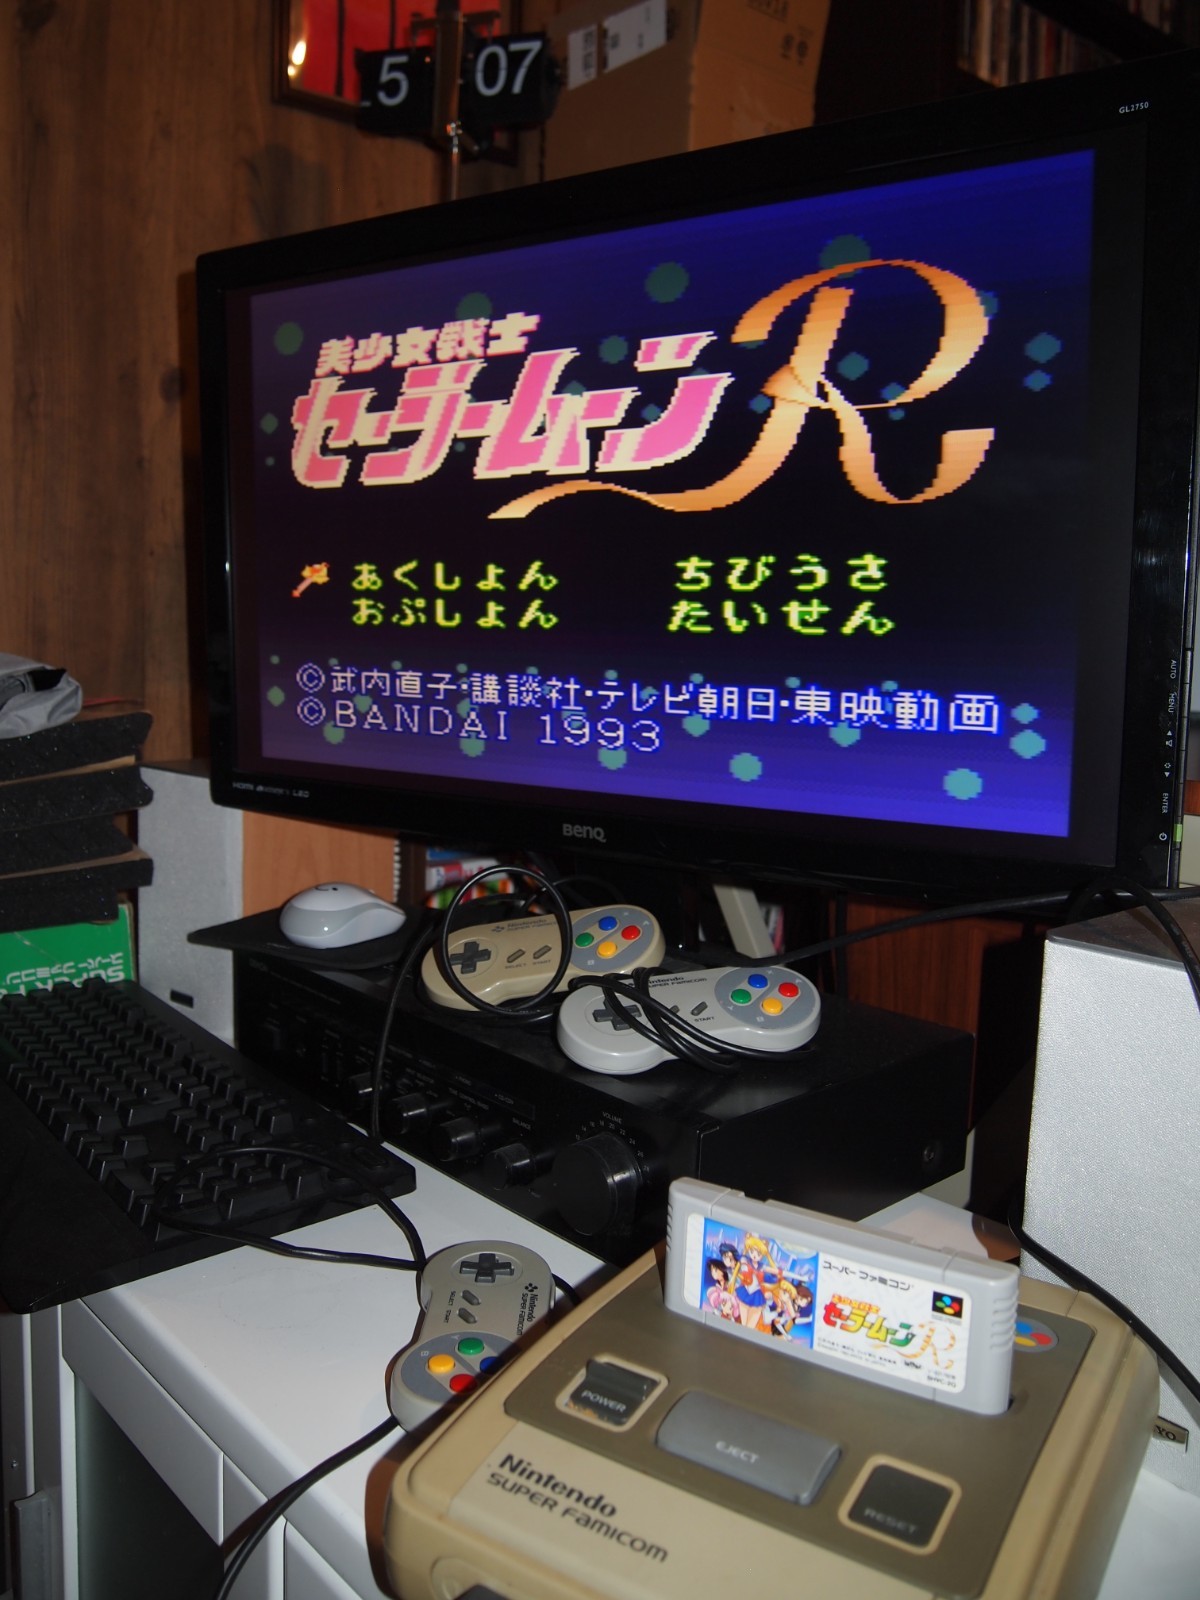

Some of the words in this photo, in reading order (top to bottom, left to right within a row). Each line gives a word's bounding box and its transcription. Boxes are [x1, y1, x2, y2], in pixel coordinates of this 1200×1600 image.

[376, 54, 410, 107] 5
[474, 39, 543, 97] 07
[1118, 100, 1149, 114] GL2750
[291, 331, 734, 488] セーラームーン
[351, 559, 559, 592] あくしょん
[674, 553, 889, 592] ちびうさ
[351, 597, 559, 629] おぷしょん
[667, 598, 896, 636] たいせん
[1169, 659, 1178, 680] AUTO
[1168, 693, 1176, 713] MENU
[538, 713, 661, 752] 1993
[1161, 792, 1169, 814] ENTER
[561, 822, 608, 844] BenQ
[648, 976, 684, 984] intendo
[602, 1111, 623, 1125] VOLUME
[526, 1292, 539, 1323] Nintendo
[822, 1301, 917, 1348] セーラームーン
[580, 1389, 627, 1414] POWER
[715, 1440, 760, 1464] EJECT
[487, 1471, 559, 1513] SUPER
[498, 1453, 617, 1518] Nintendo
[863, 1507, 919, 1535] RESET
